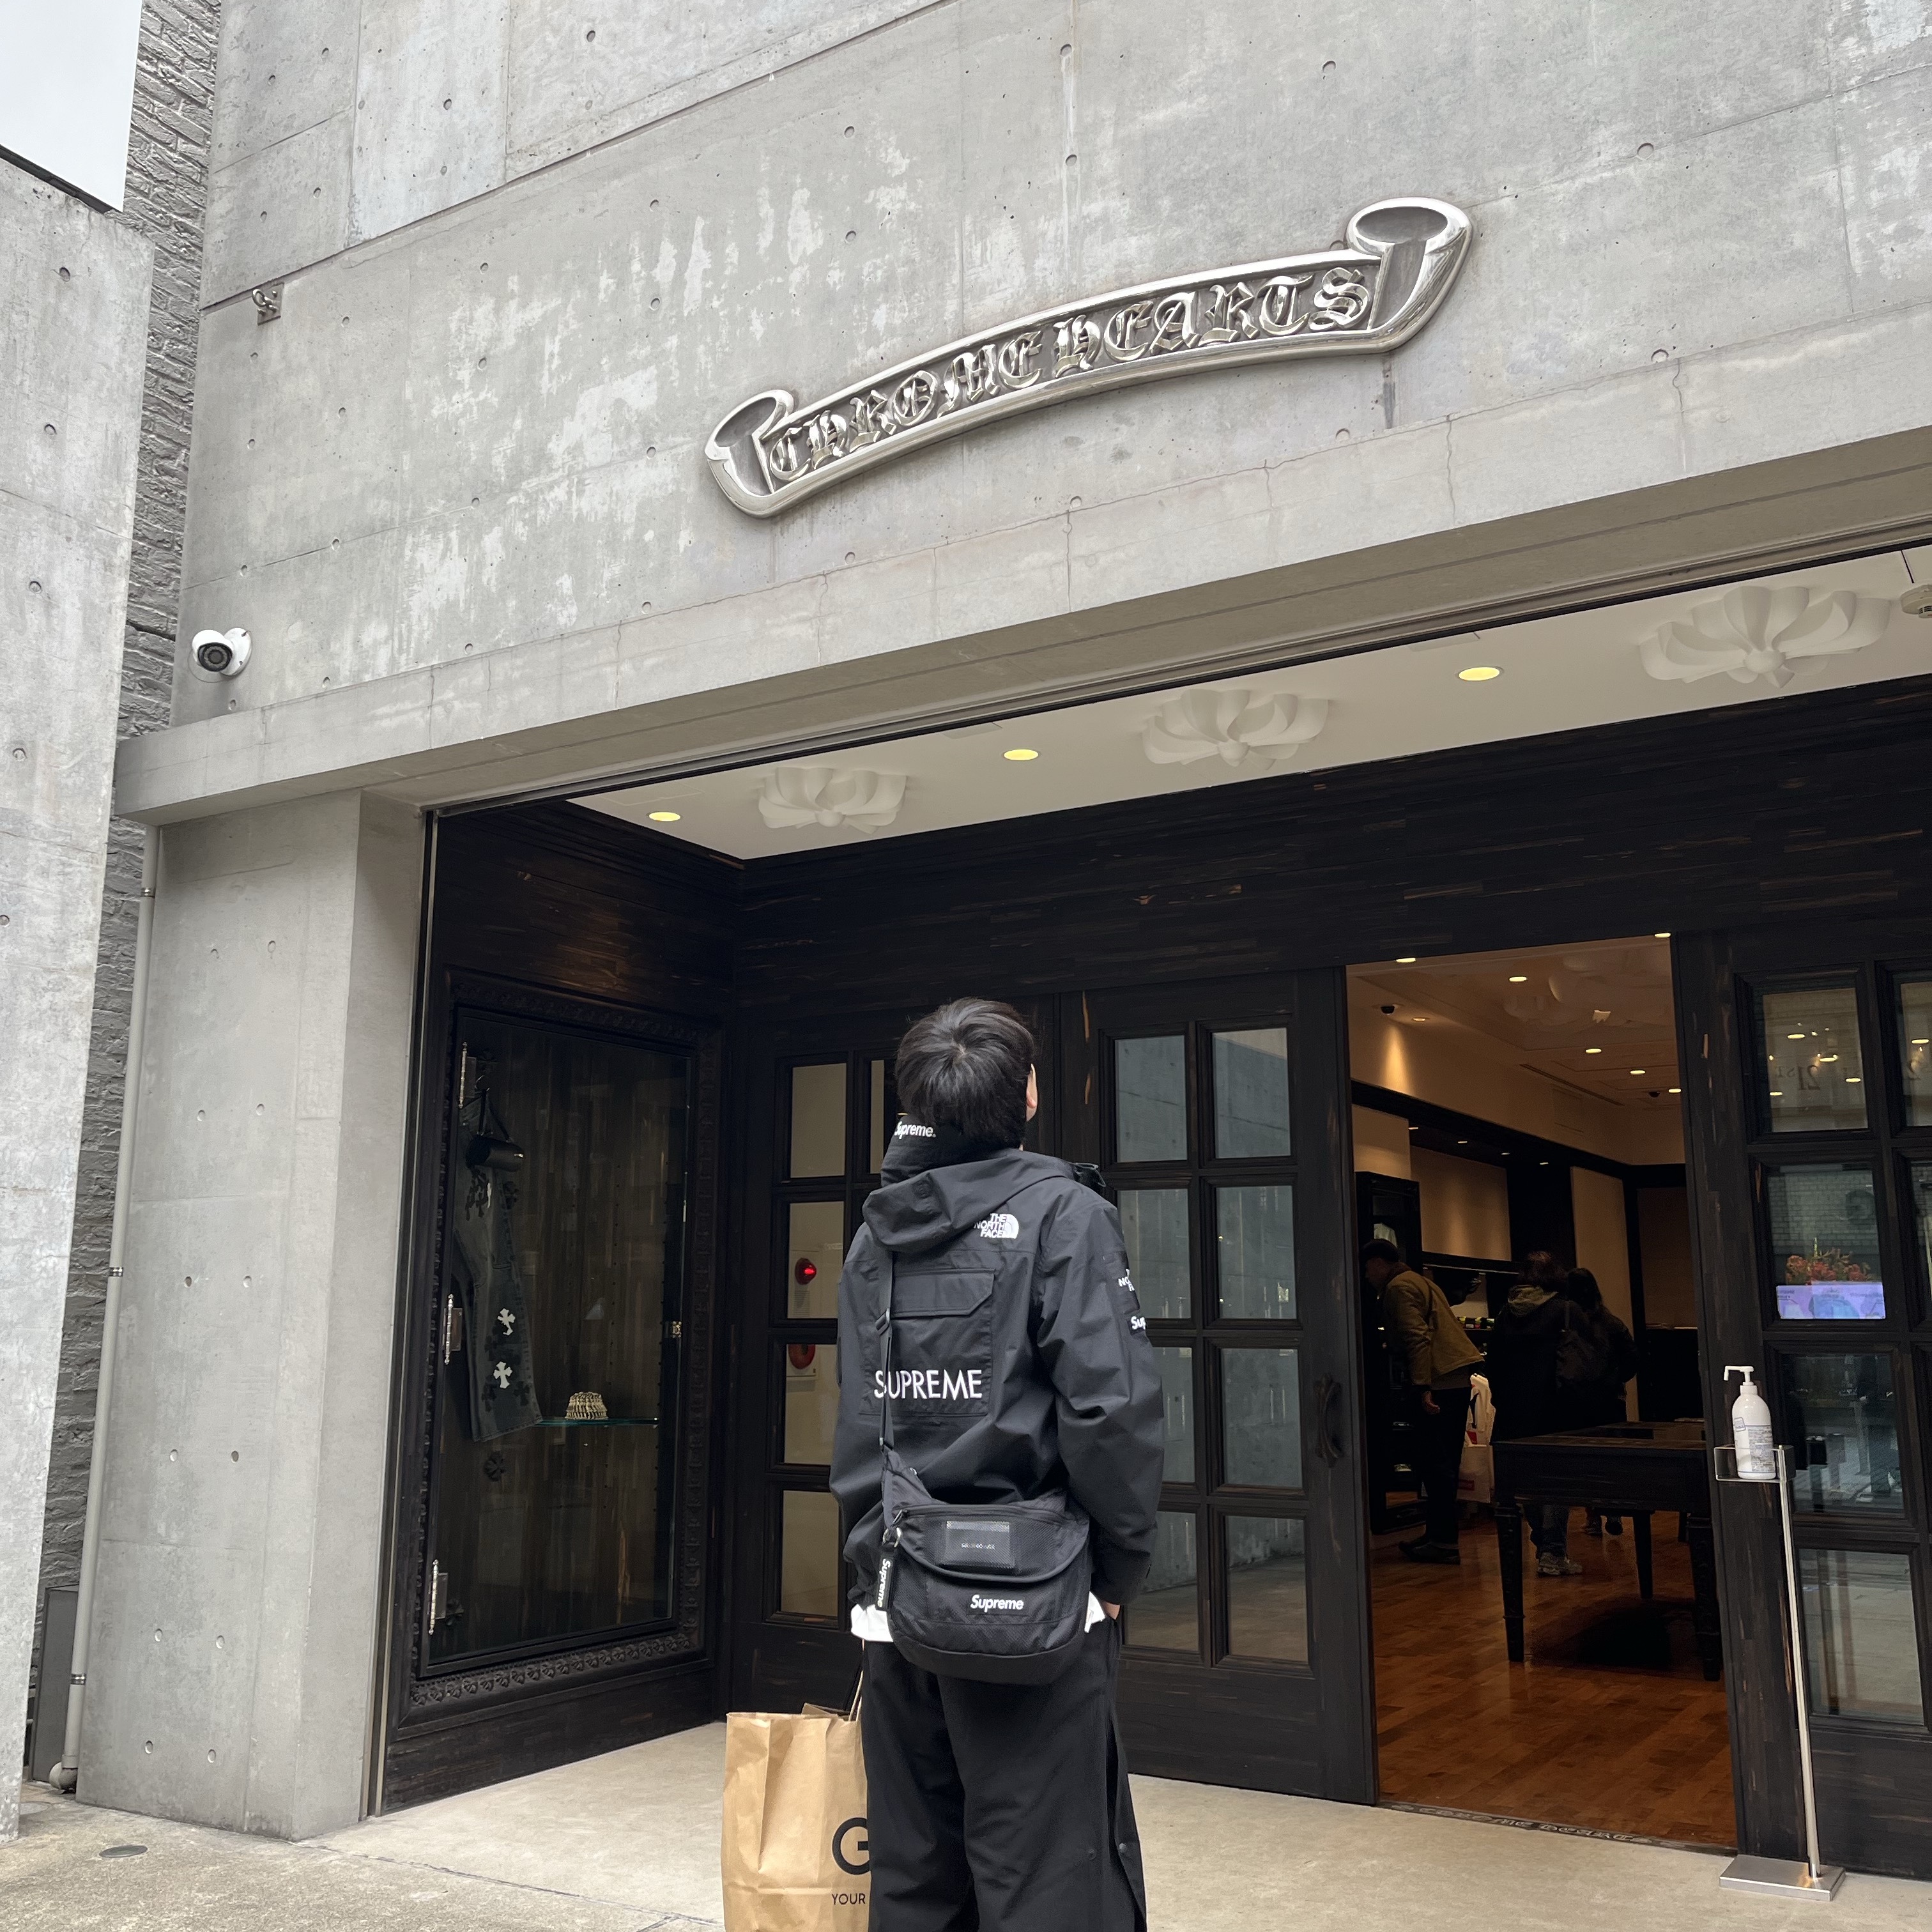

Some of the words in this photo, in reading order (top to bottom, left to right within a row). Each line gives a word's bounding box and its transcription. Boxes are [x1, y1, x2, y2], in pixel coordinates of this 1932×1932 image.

[769, 330, 1043, 482] CHROME
[1053, 266, 1372, 378] HEARTS
[974, 1220, 1006, 1230] NORTH
[990, 1213, 1008, 1223] THE
[980, 1229, 1004, 1238] FACE
[874, 1368, 983, 1400] SUPREME
[877, 1558, 891, 1607] Supreme
[969, 1594, 1024, 1613] Supreme
[831, 1893, 866, 1905] YOUR
